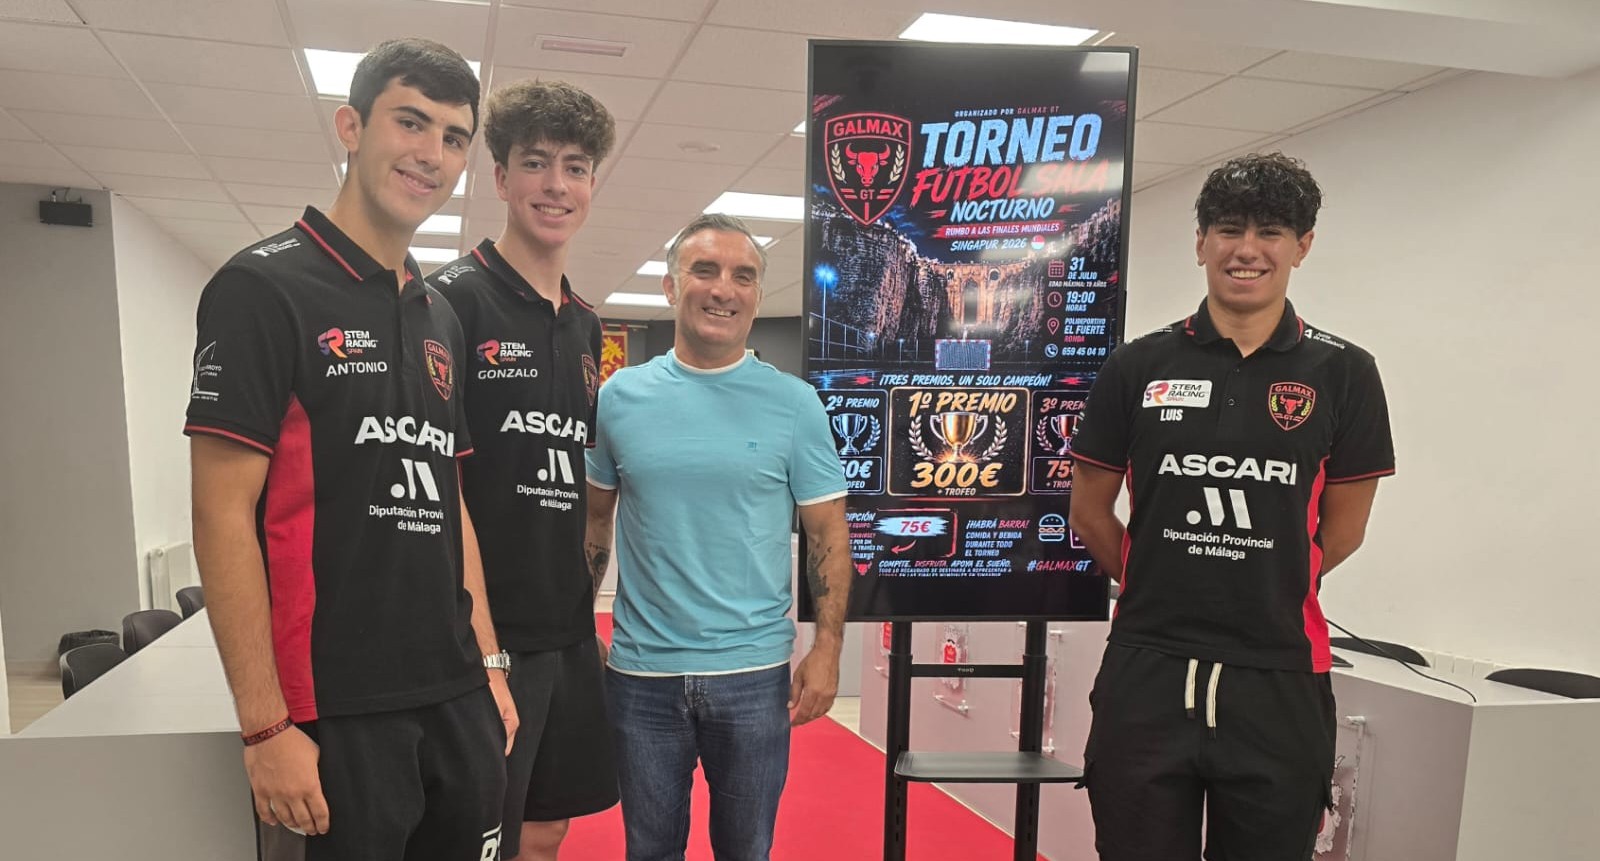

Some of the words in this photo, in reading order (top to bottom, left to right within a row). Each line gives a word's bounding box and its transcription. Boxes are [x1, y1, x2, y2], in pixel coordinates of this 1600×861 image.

[1000, 108, 1015, 116] POR
[833, 119, 904, 139] GALMAX
[920, 113, 1102, 169] TORNEO
[1033, 159, 1110, 198] SALA
[860, 189, 875, 200] GT
[950, 197, 1055, 223] NOCTURNO
[945, 228, 970, 236] RUMBO
[977, 227, 991, 235] LAS
[992, 225, 1020, 234] FINALES
[1021, 223, 1060, 233] MUNDIALES
[950, 240, 999, 252] SINGAPUR
[1001, 238, 1027, 250] 2026
[1069, 257, 1085, 272] 31
[1067, 272, 1077, 280] DE
[1078, 272, 1098, 280] JULIO
[1066, 291, 1096, 304] 19:00
[344, 331, 370, 339] STEM
[1064, 326, 1074, 335] EL
[1075, 326, 1106, 335] FUERTE
[345, 340, 377, 348] RACING
[500, 342, 526, 350] STEM
[1061, 348, 1076, 356] 659
[1076, 348, 1086, 356] 45
[1086, 348, 1096, 356] 04
[1097, 348, 1106, 356] 10
[326, 361, 388, 378] ANTONIO
[478, 369, 538, 380] GONZALO
[879, 375, 909, 386] ¡TRES
[911, 375, 954, 387] PREMIOS,
[958, 375, 974, 386] UN
[975, 375, 1001, 386] SOLO
[1003, 373, 1053, 387] CAMPEÓN!
[1171, 384, 1202, 392] STEM
[1274, 386, 1312, 398] GALMAX
[845, 398, 880, 409] PREMIO
[935, 392, 1017, 414] PREMIO
[1160, 409, 1183, 422] LUIS
[354, 416, 455, 458] ASCARI
[910, 462, 1003, 488] 300€
[1046, 460, 1073, 479] 75
[1158, 454, 1297, 486] ASCARI
[944, 488, 976, 496] TROFEO
[397, 520, 407, 531] de
[407, 521, 441, 535] Málaga
[900, 521, 931, 533] 75€
[998, 520, 1030, 529] BARRA!
[1163, 529, 1220, 544] Diputación
[1222, 534, 1274, 549] Provincial
[1188, 545, 1203, 555] de
[1205, 546, 1246, 560] Málaga
[951, 560, 974, 568] APOYA
[975, 560, 984, 568] EL
[1026, 560, 1092, 572] #GALMAXGT
